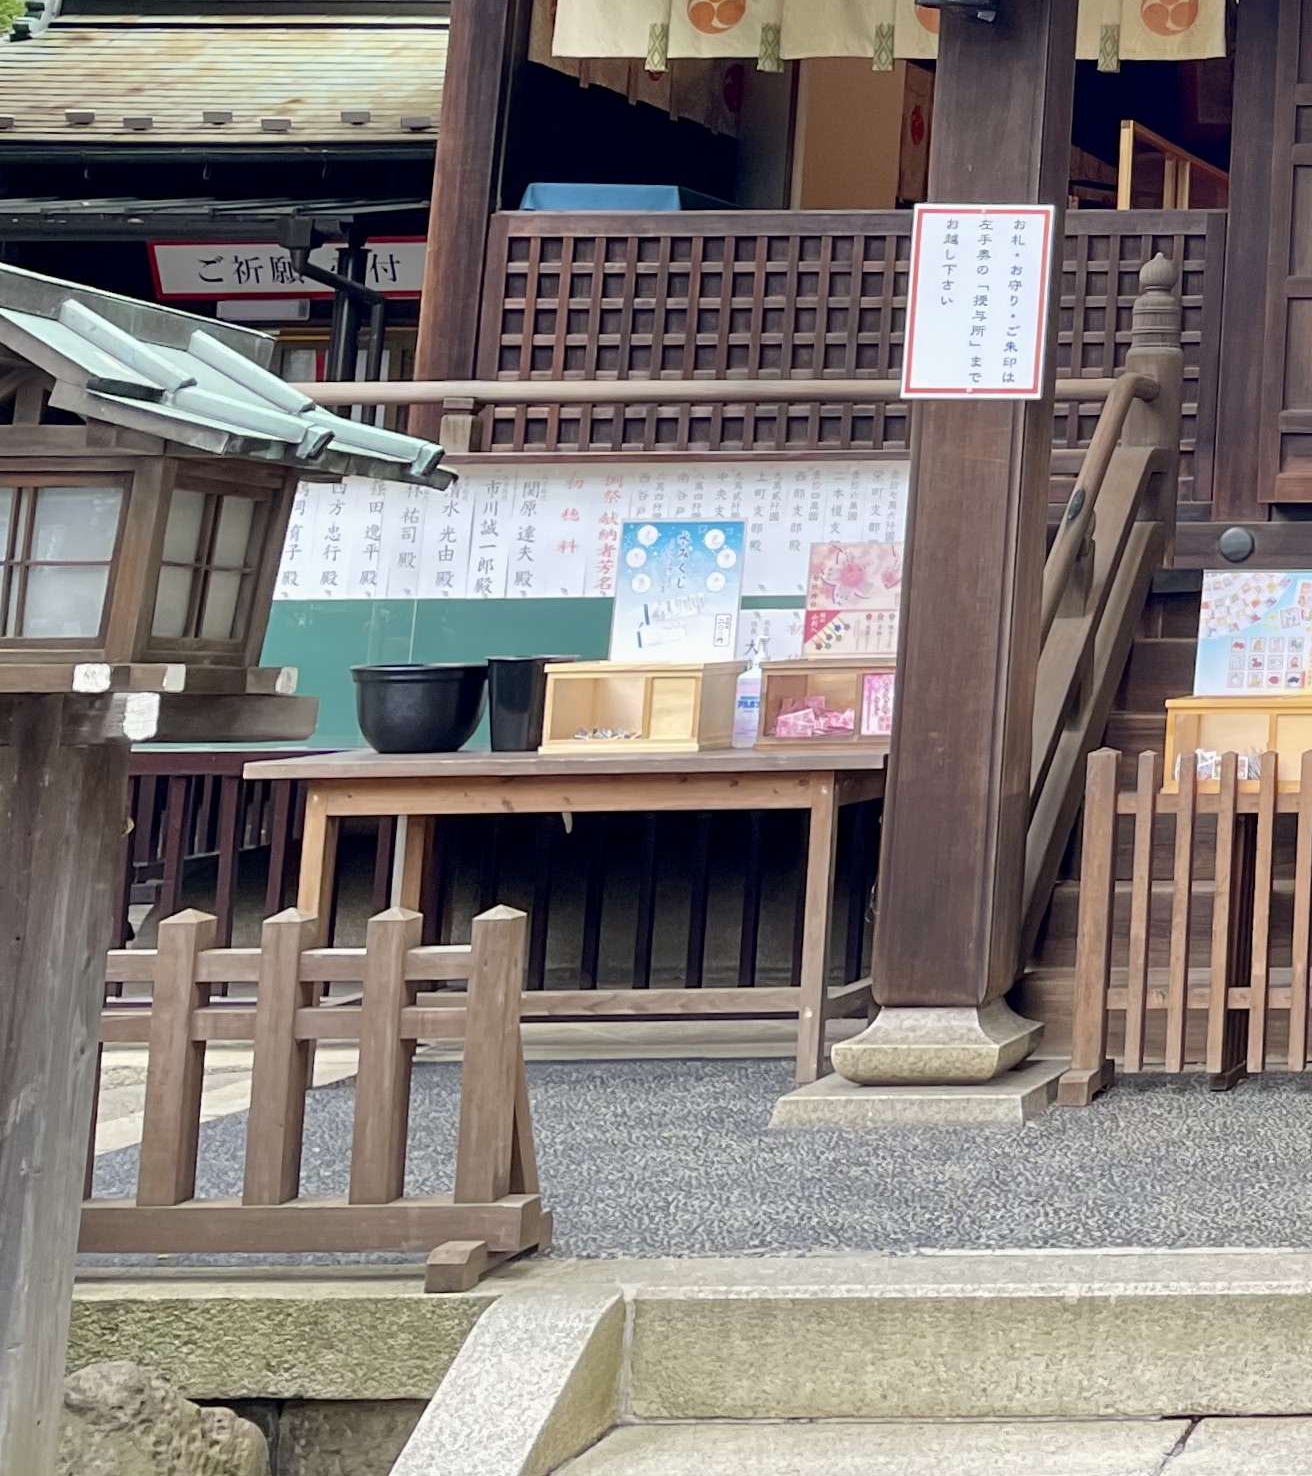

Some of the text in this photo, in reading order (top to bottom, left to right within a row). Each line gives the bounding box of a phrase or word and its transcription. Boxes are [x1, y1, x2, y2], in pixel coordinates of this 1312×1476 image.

[198, 253, 401, 285] ご祈願付
[941, 218, 959, 305] お越し下さい
[969, 219, 993, 383] 左手奥の「授与所」まで
[1002, 219, 1026, 383] お札・お守り・ご朱印は
[829, 472, 844, 543] 二本榎支
[868, 470, 885, 542] 栄町支部
[676, 530, 691, 589] 水みくじ
